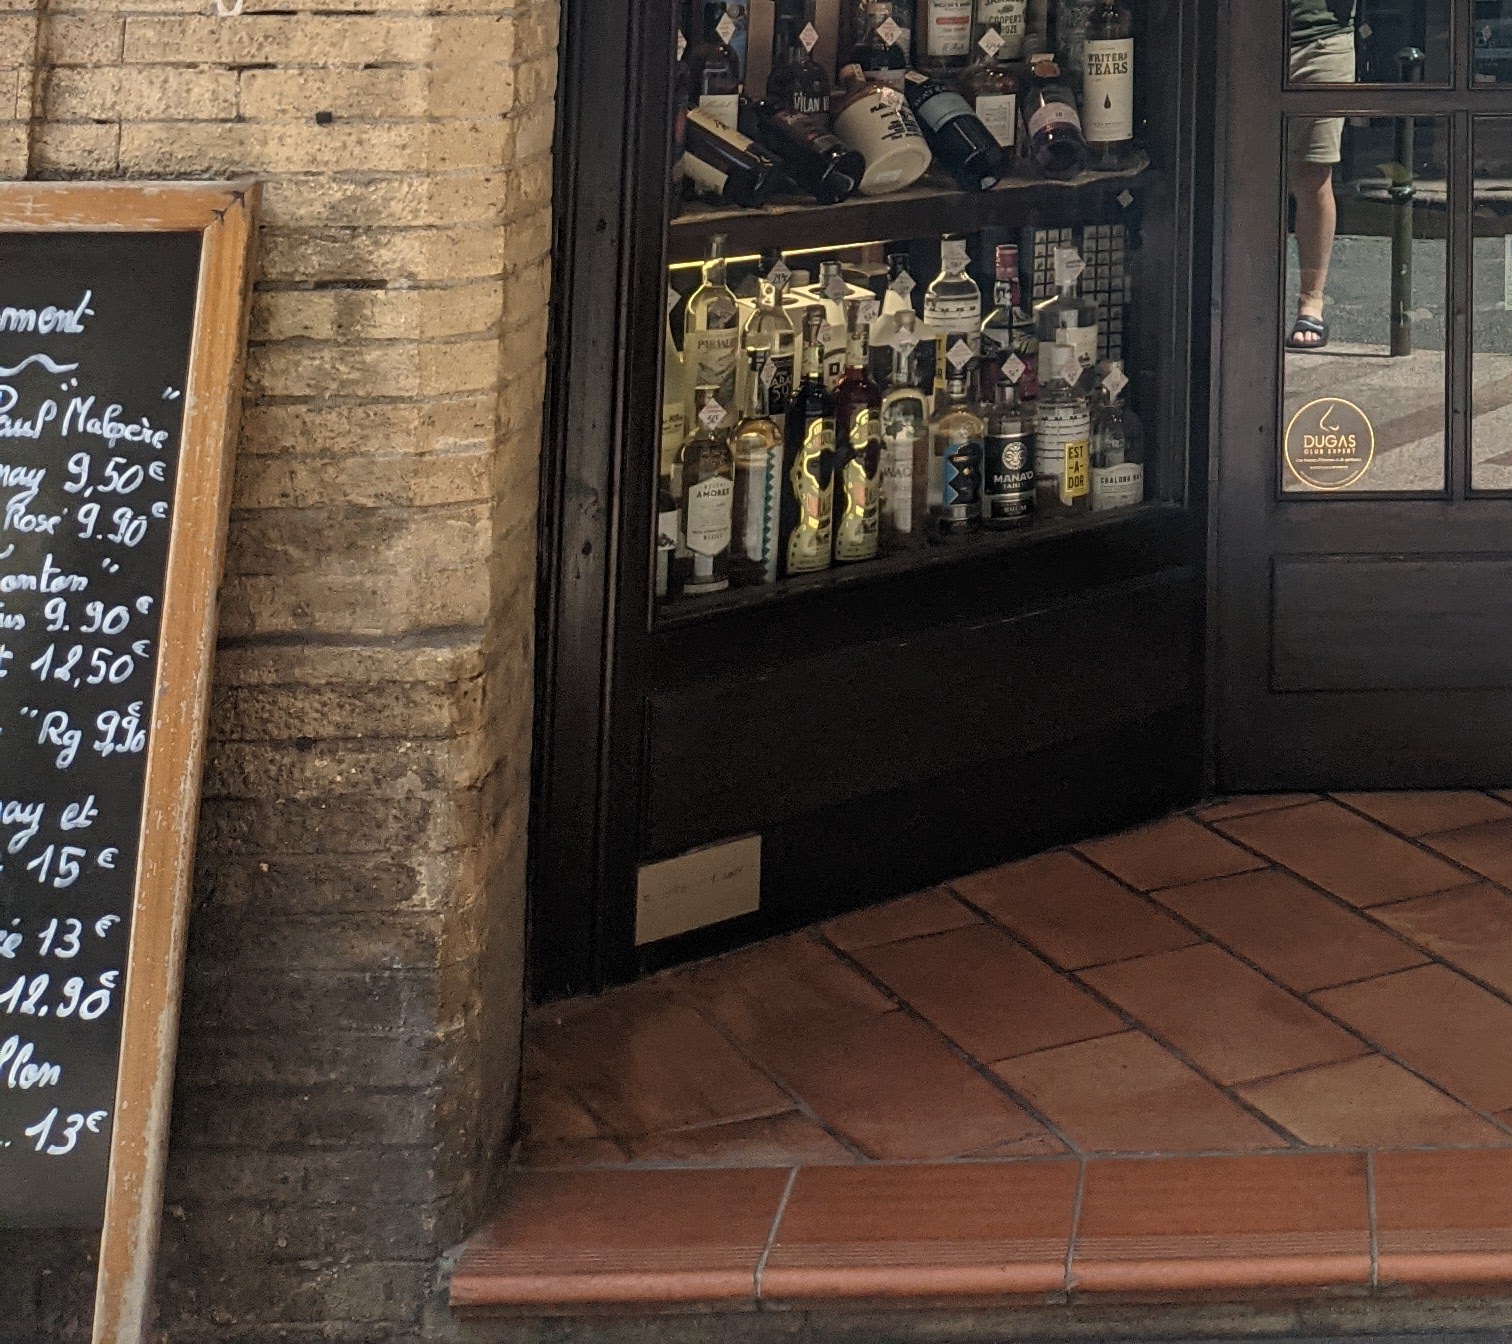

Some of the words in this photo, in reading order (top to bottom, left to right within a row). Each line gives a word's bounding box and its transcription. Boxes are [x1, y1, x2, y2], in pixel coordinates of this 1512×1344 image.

[1087, 62, 1129, 76] TEARS
[1303, 434, 1356, 448] DUGAS
[1068, 446, 1084, 459] EST
[1068, 475, 1085, 489] DOR
[696, 488, 730, 499] AMORES
[60, 794, 99, 831] et
